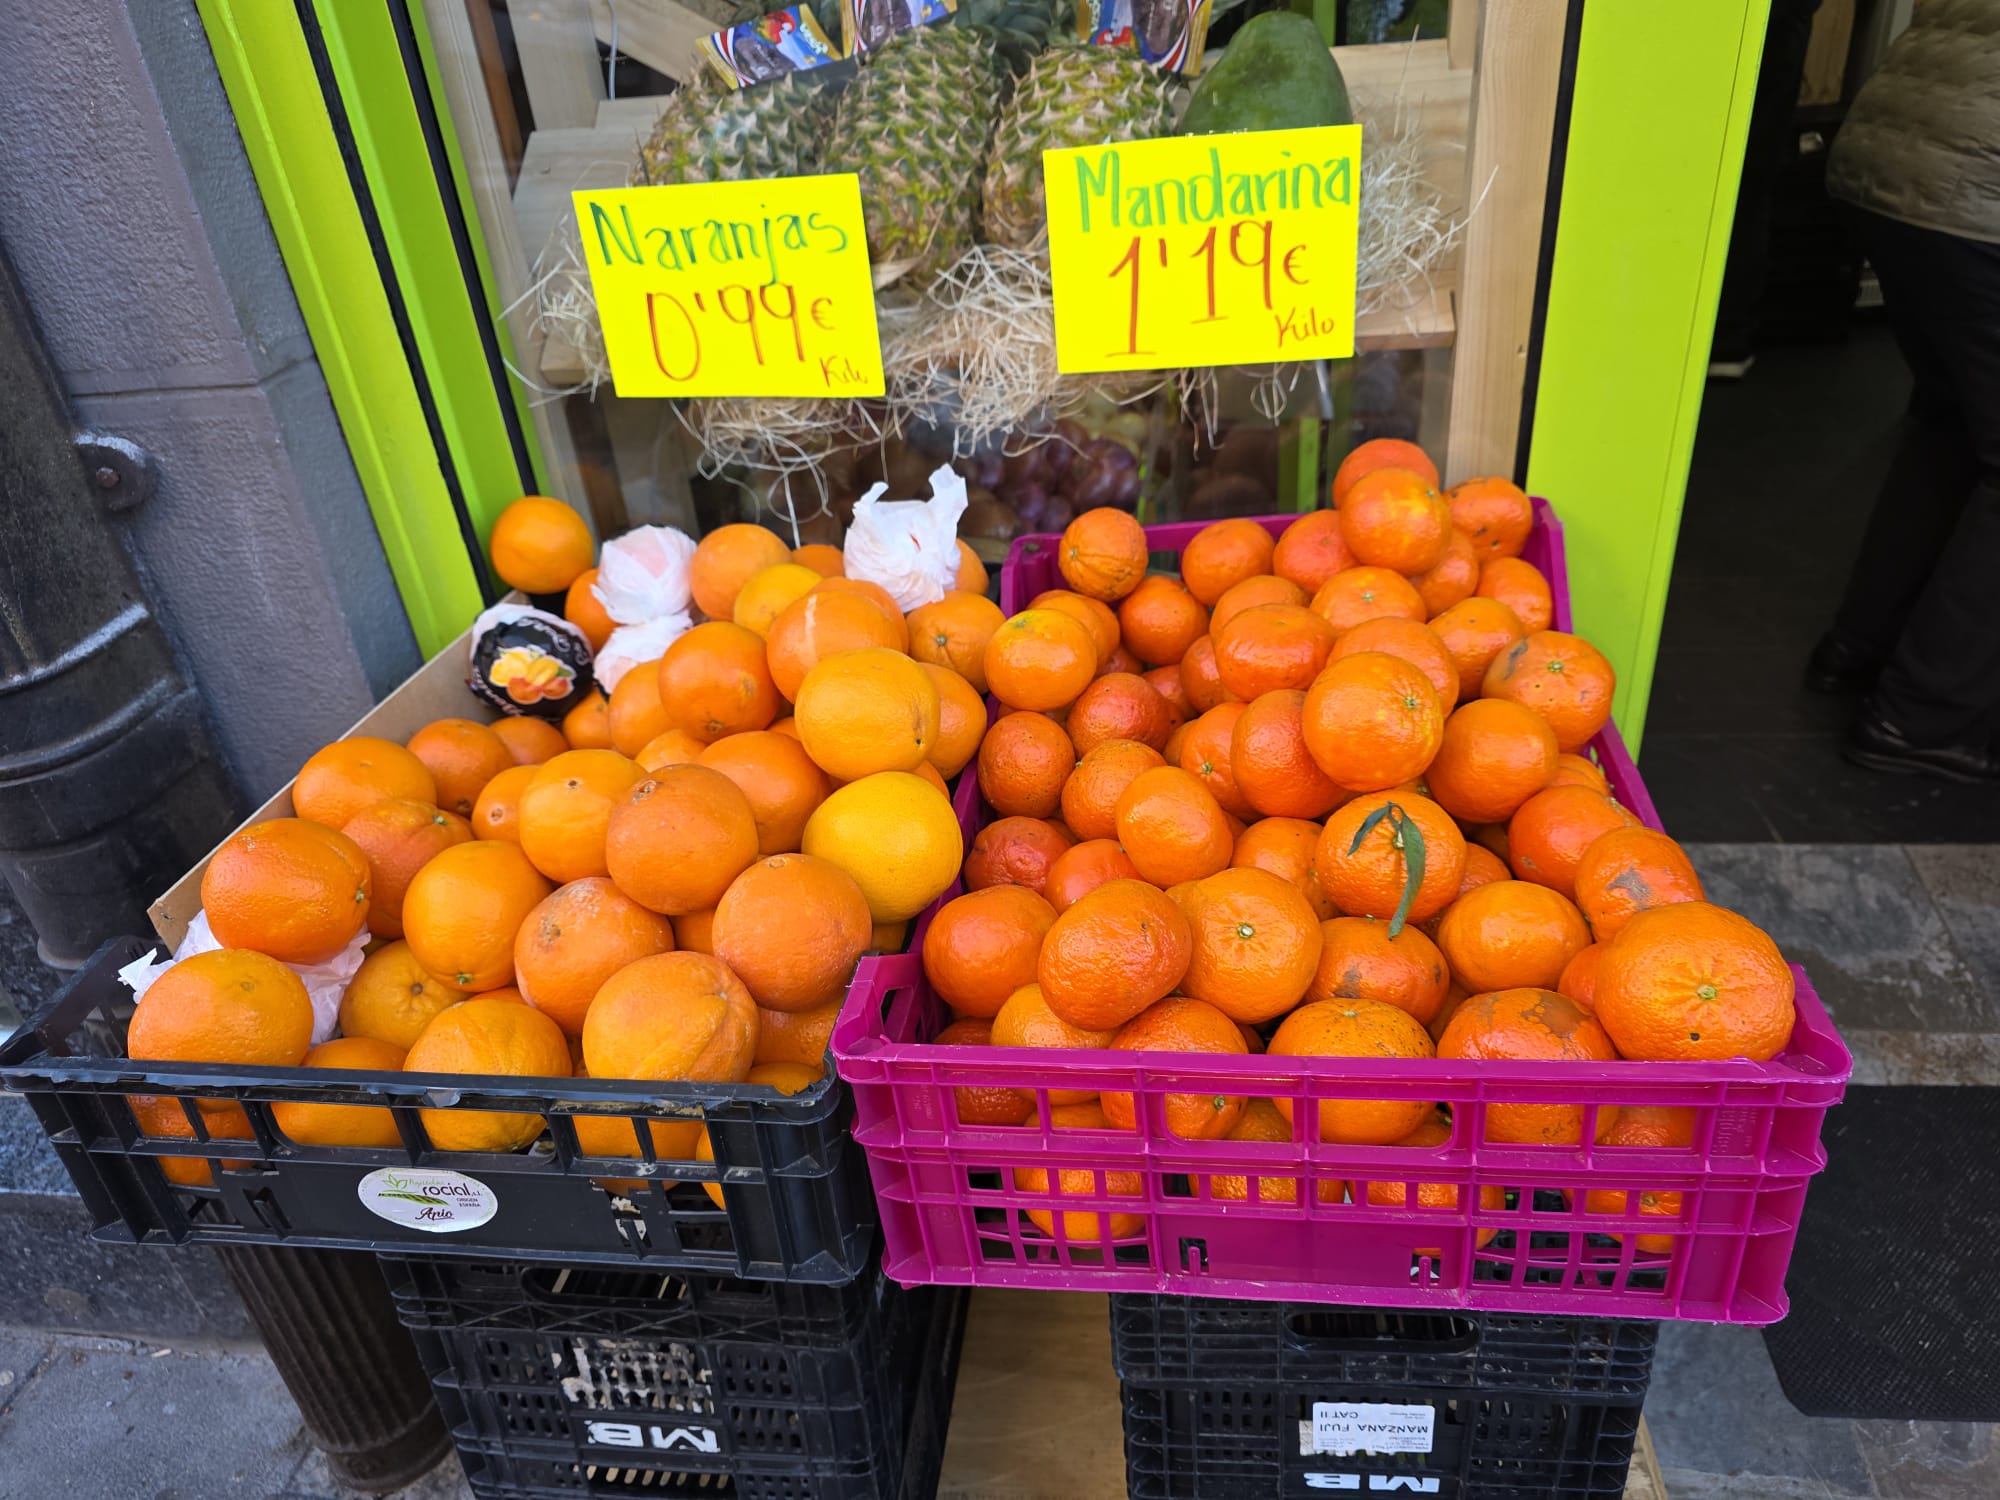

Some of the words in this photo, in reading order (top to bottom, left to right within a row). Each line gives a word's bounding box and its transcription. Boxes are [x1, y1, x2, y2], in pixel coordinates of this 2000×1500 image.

[1074, 147, 1351, 233] Mandarina
[589, 201, 848, 288] Naranjas
[1273, 307, 1335, 348] Kilo
[422, 1183, 471, 1196] rocial
[415, 1207, 455, 1221] Apio
[1332, 1411, 1359, 1419] CAT
[584, 1420, 721, 1453] MB
[1319, 1423, 1351, 1433] FUJI
[1357, 1424, 1429, 1434] MANZANA
[1303, 1472, 1440, 1493] MB
